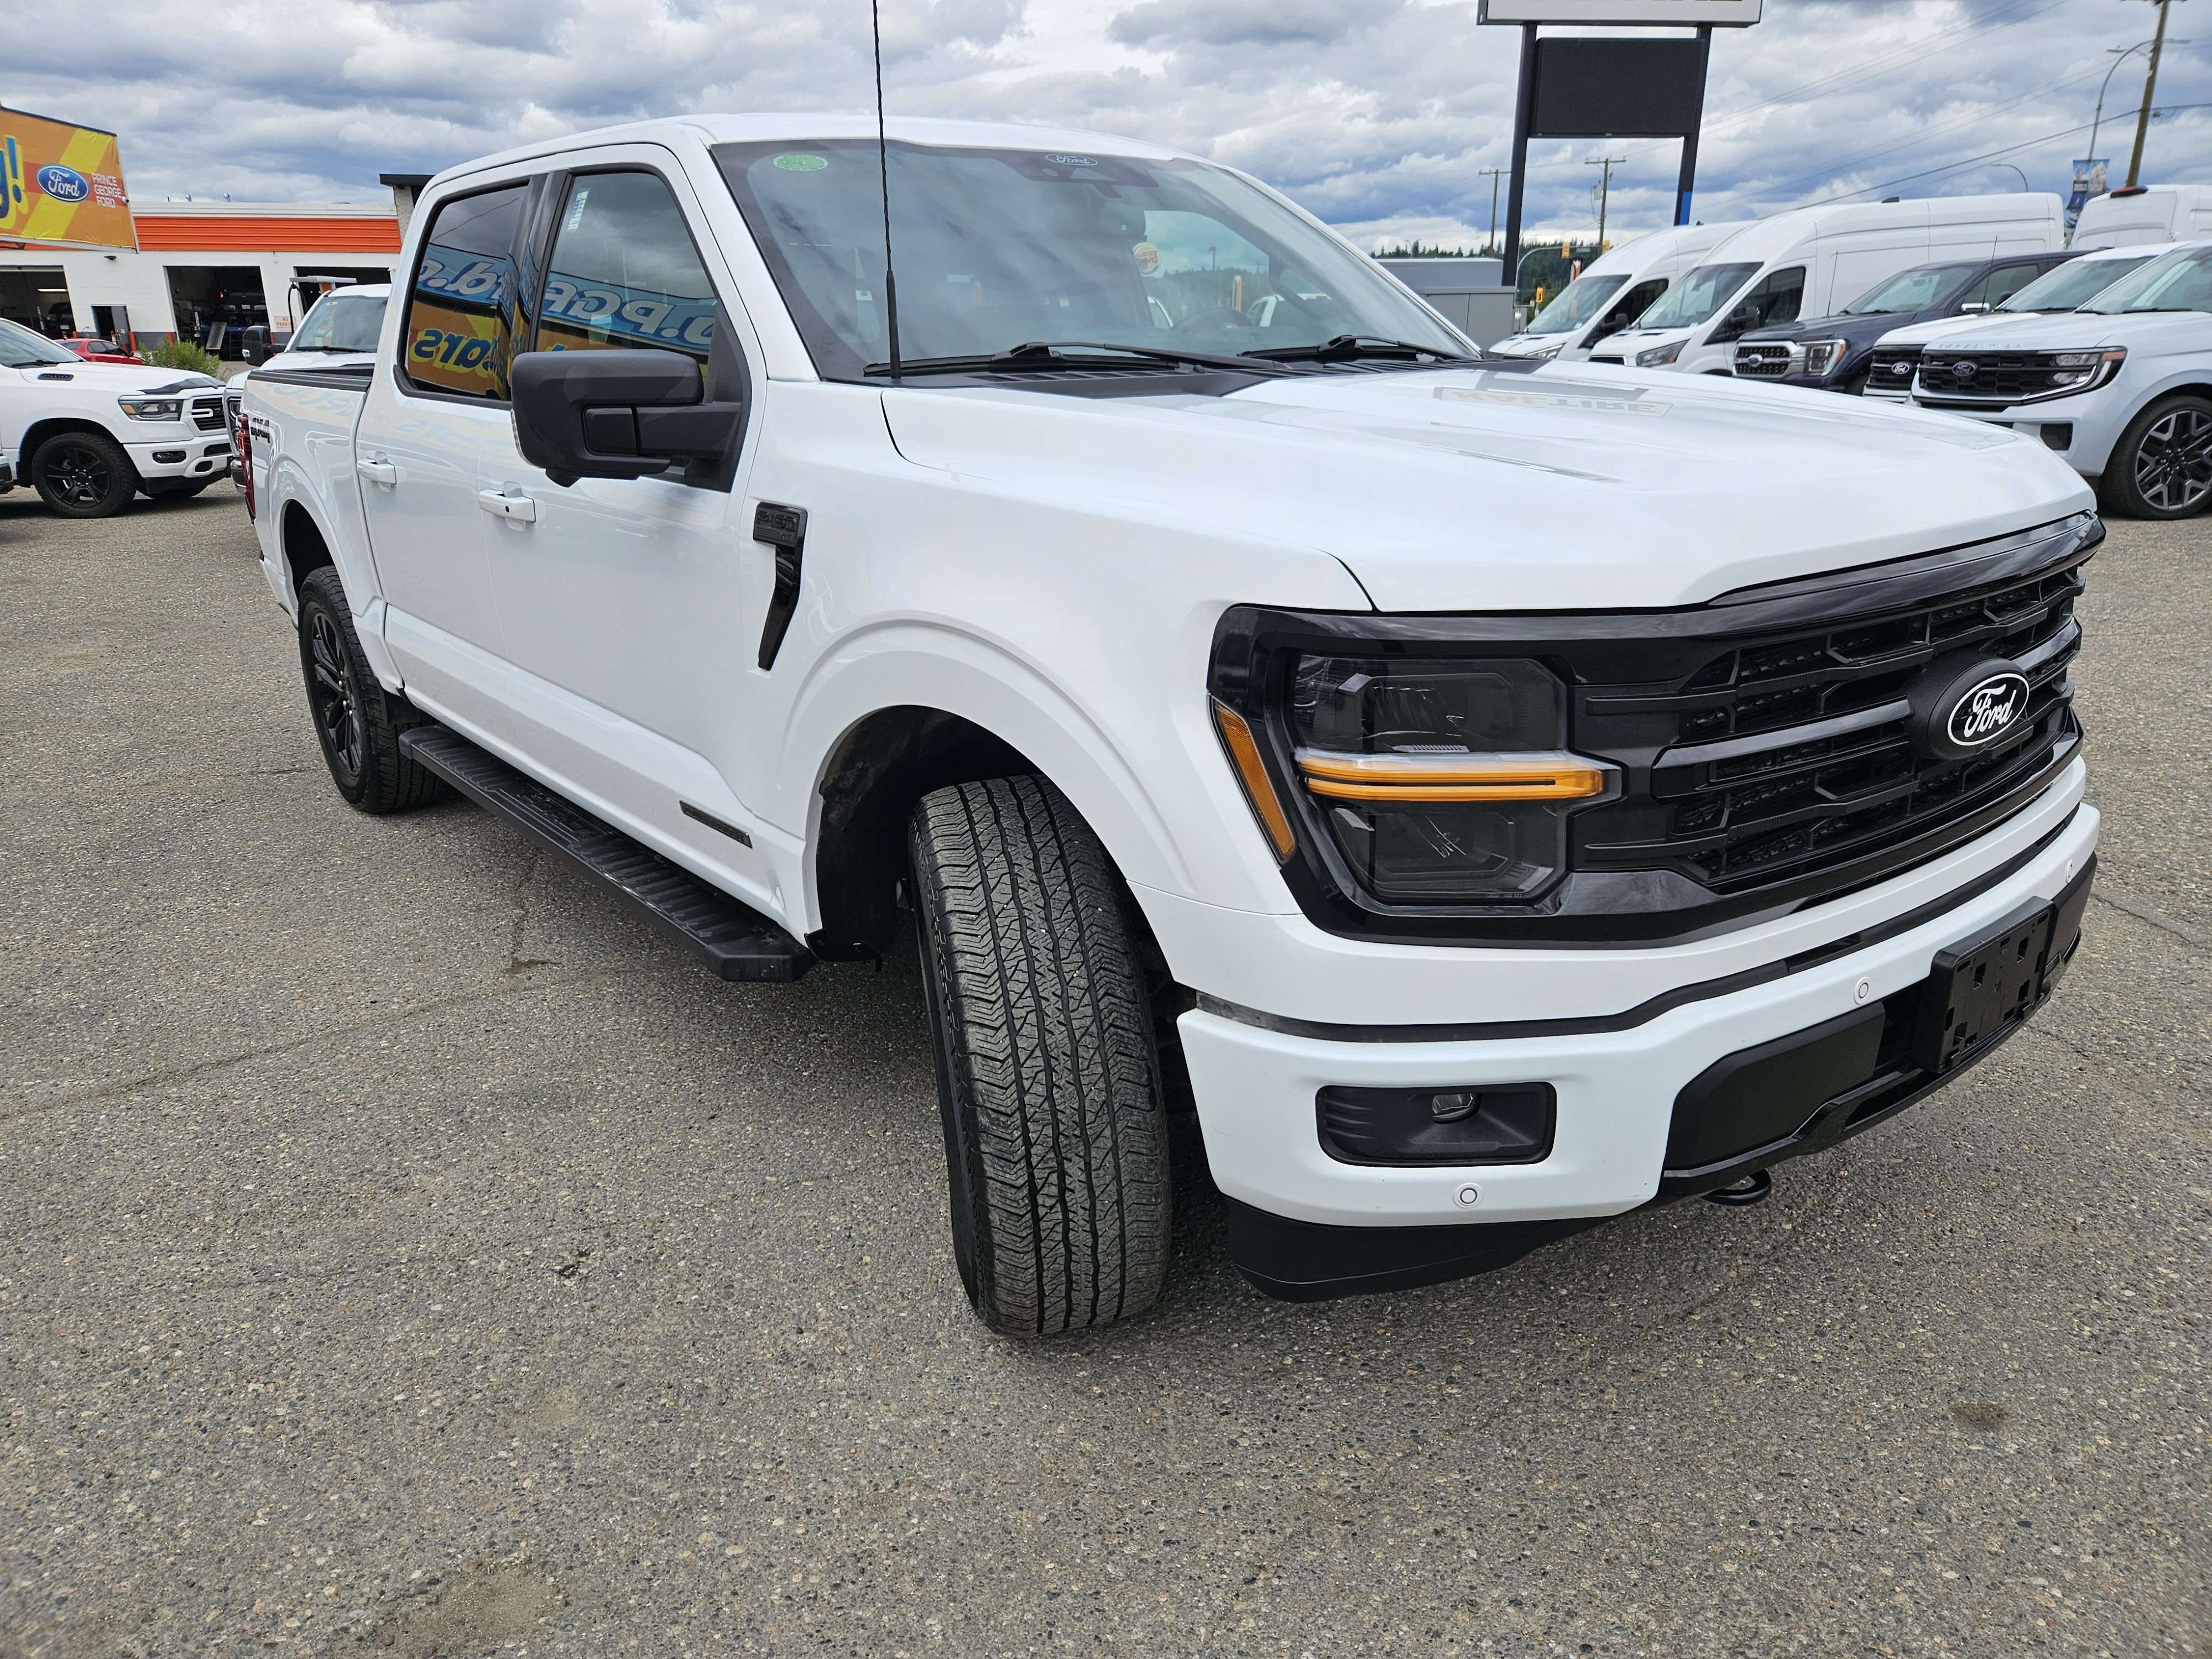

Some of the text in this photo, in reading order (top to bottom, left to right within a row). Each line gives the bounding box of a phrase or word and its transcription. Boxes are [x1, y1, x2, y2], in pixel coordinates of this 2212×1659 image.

[1056, 155, 1090, 164] Ford
[48, 169, 80, 197] Ford
[92, 173, 118, 186] PRINCE
[94, 184, 122, 198] GEORGE
[96, 196, 115, 208] FORD
[1964, 684, 2017, 738] Ford
